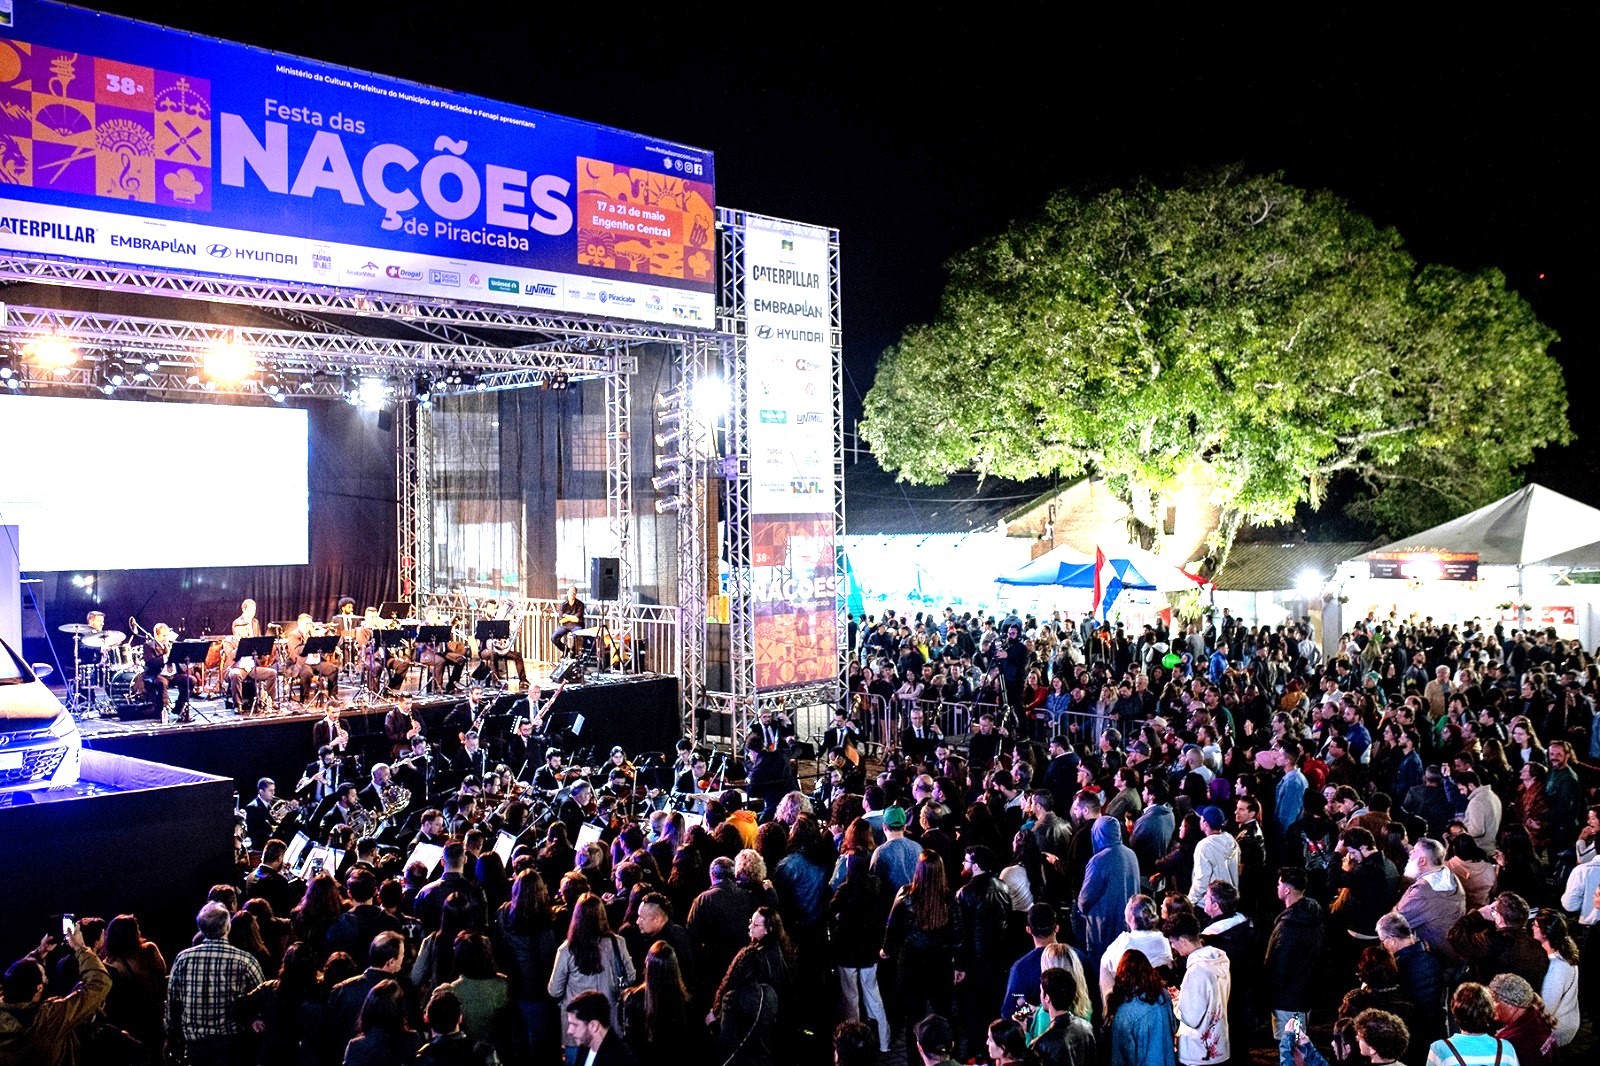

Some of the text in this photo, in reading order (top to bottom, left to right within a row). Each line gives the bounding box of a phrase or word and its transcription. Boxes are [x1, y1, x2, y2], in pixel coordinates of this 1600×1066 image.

[276, 64, 312, 79] Ministério
[314, 73, 323, 81] da
[324, 75, 353, 89] Cultura,
[353, 81, 387, 96] Prefeitura
[388, 89, 398, 98] do
[431, 98, 439, 108] de
[440, 101, 472, 115] Piracicaba
[478, 110, 499, 121] Fenapi
[265, 98, 366, 134] Festa das
[220, 111, 573, 236] NAÇÕES
[597, 201, 665, 222] 17 a 21 de maio
[0, 217, 95, 244] ATERPILLAR
[404, 217, 529, 251] de Piracicaba
[592, 216, 671, 238] Engenho Central
[110, 234, 197, 255] EMBRAPLAN
[235, 248, 298, 265] HYUNDAI
[400, 269, 421, 278] Drogal
[490, 280, 511, 288] Unimed
[752, 265, 820, 290] CATERPILLAR
[525, 284, 558, 296] UNIMIL
[608, 293, 636, 304] Piracicaba
[754, 299, 823, 319] EMBRAPLAN
[776, 328, 824, 343] HYUNDAI
